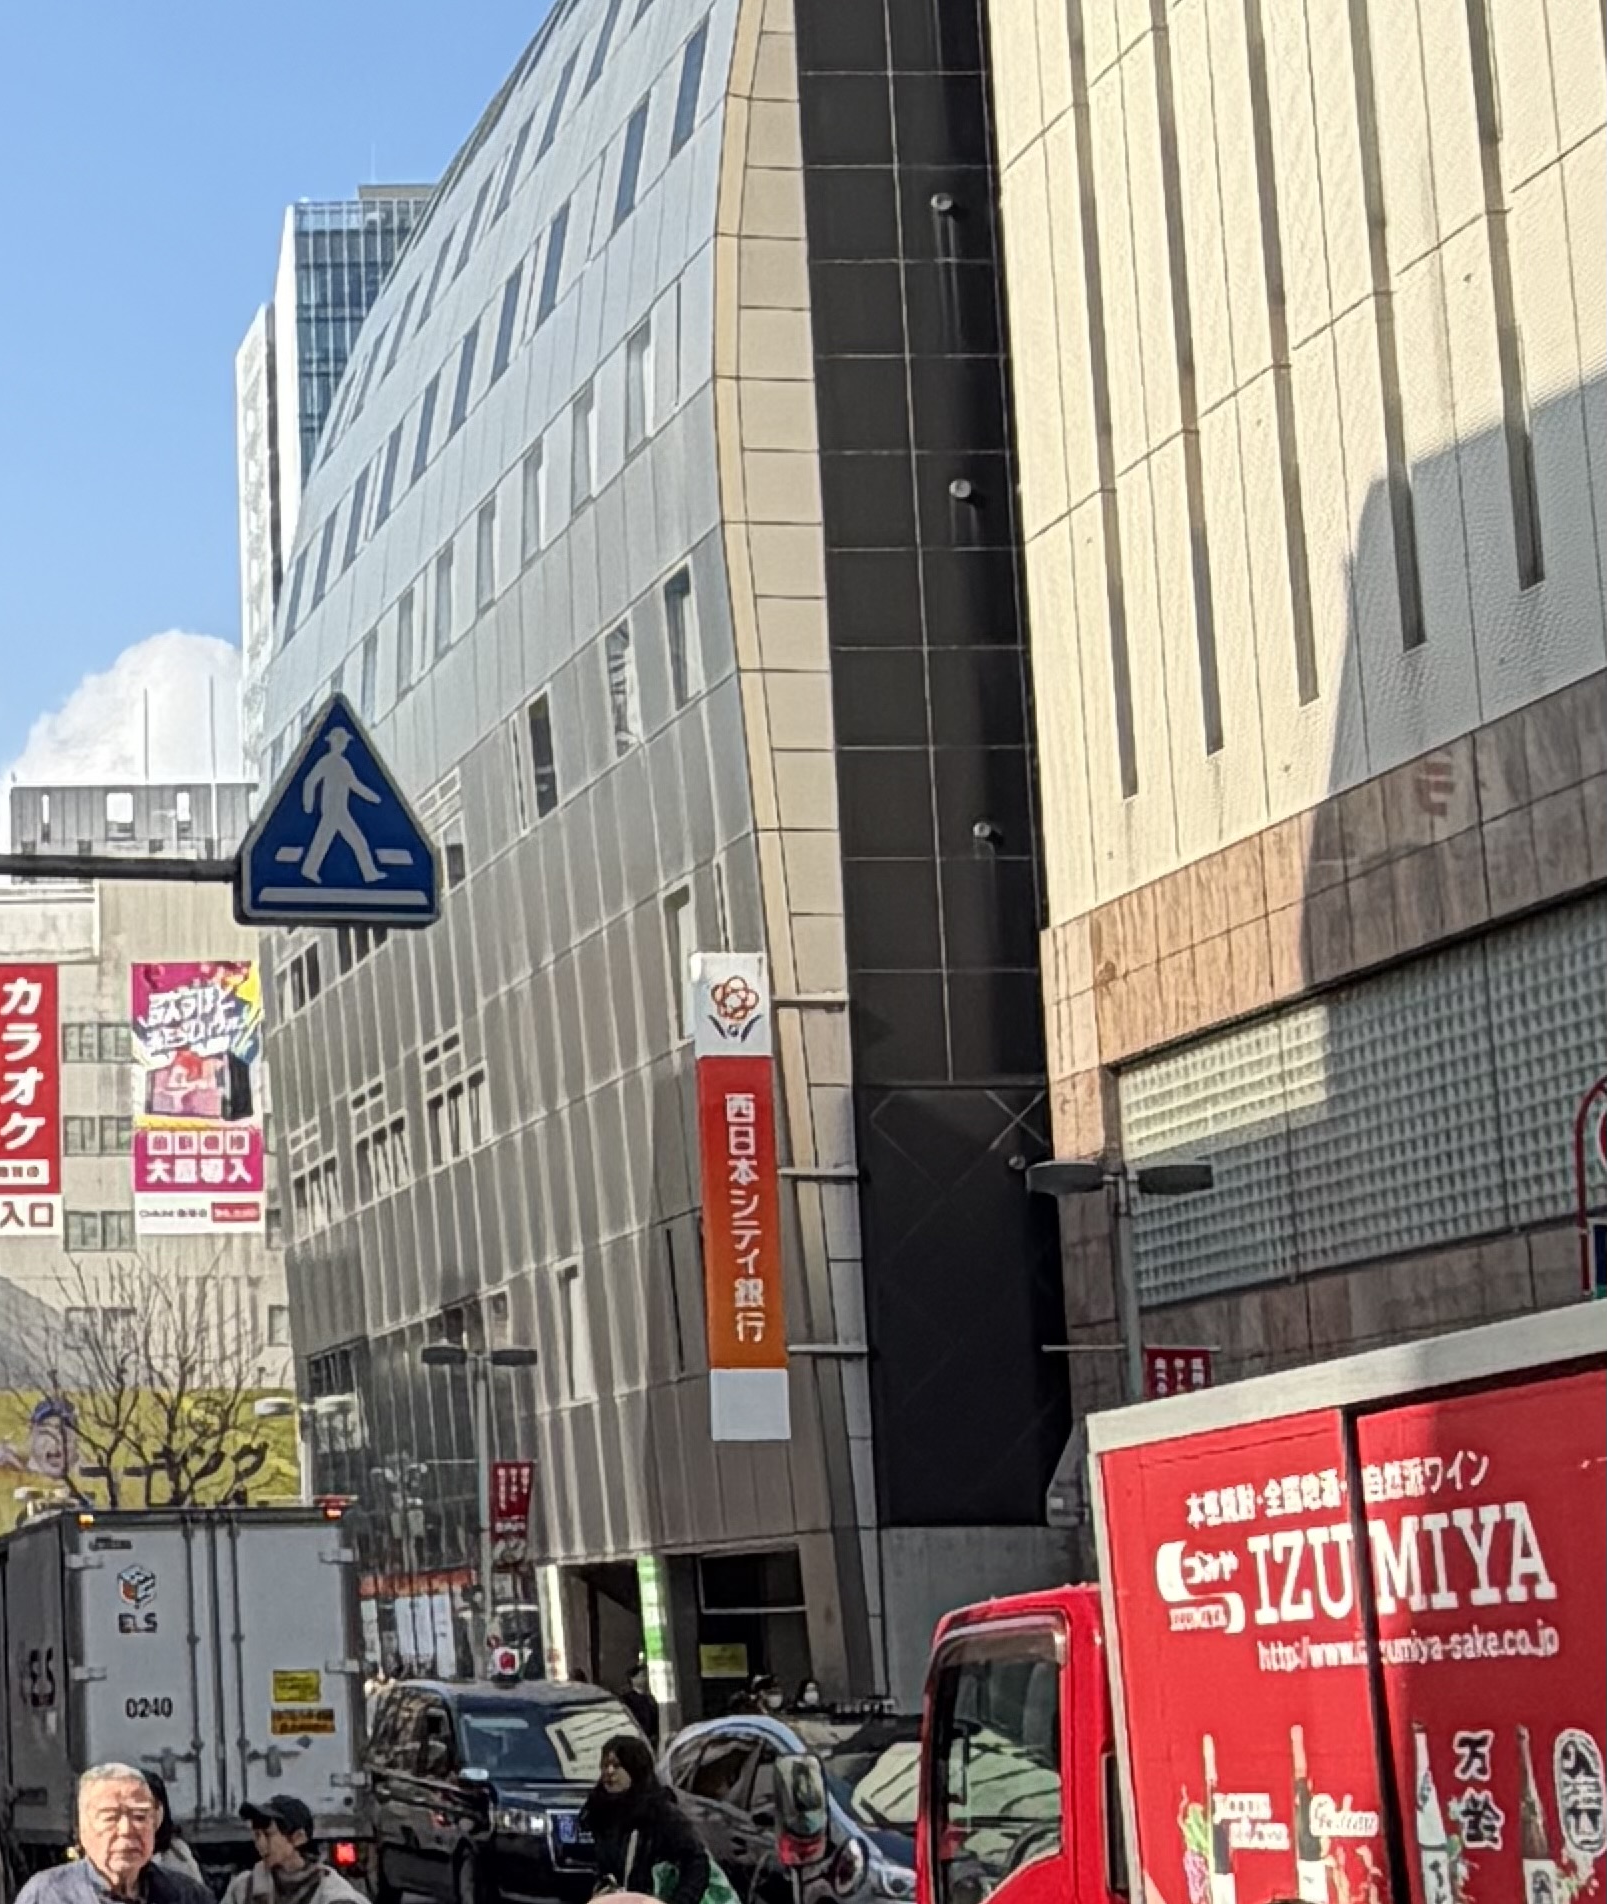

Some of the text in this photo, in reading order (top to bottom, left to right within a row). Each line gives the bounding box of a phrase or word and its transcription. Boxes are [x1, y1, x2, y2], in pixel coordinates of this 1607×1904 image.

[0, 977, 46, 1151] カラオケ
[725, 1093, 767, 1343] 西日本シティ銀行
[118, 1612, 158, 1634] ELS
[1247, 1500, 1558, 1626] IZUMIYA
[125, 1697, 174, 1719] 0240
